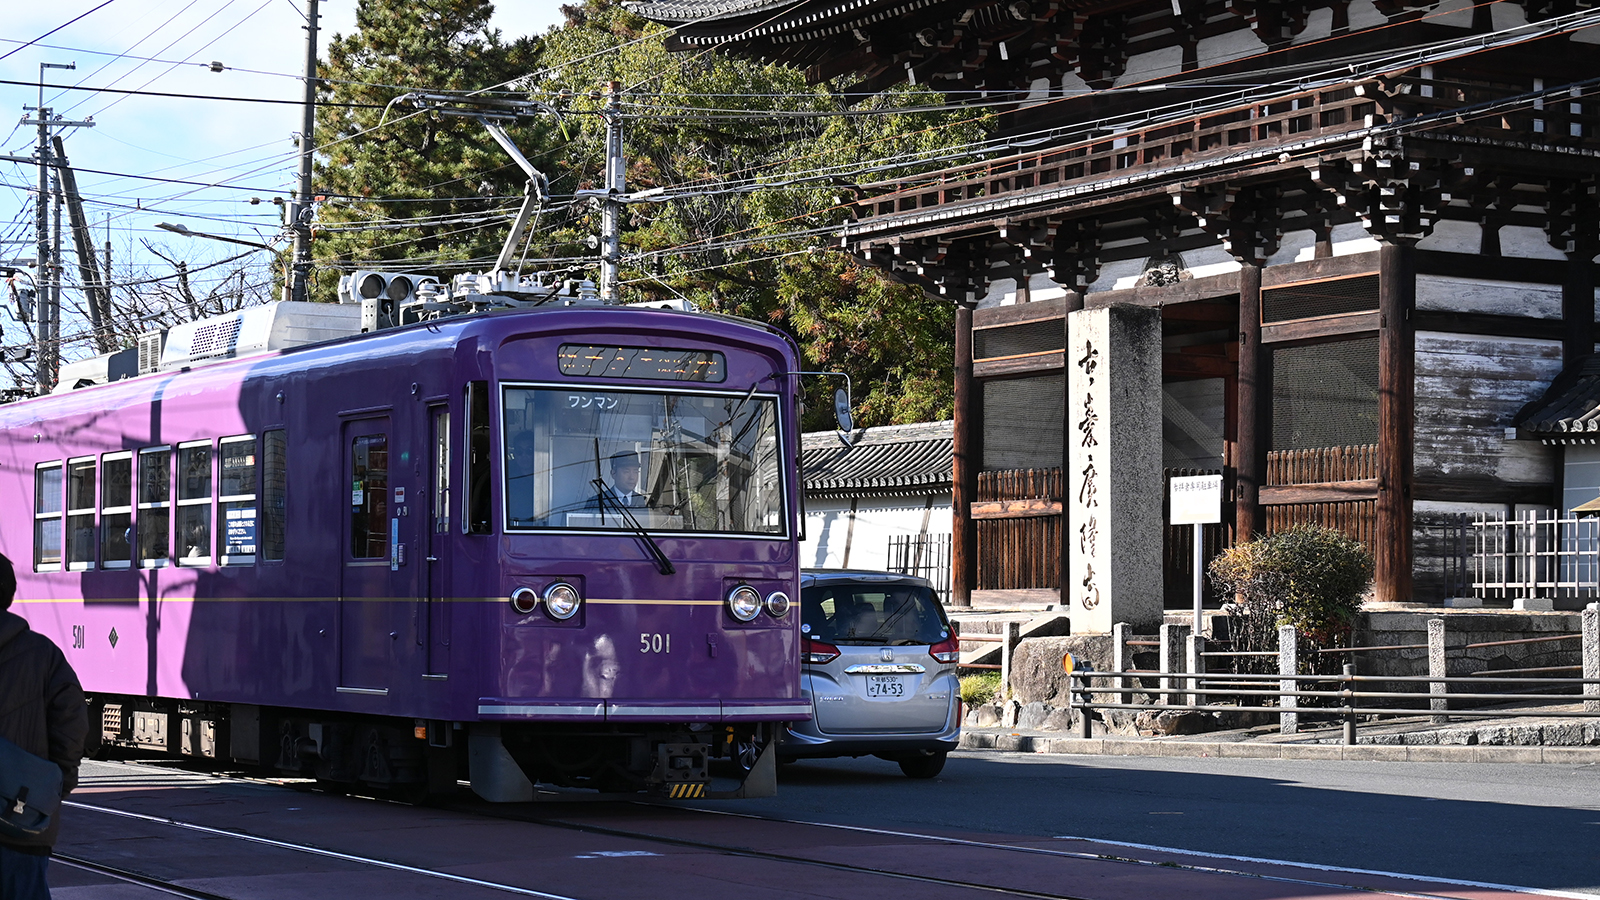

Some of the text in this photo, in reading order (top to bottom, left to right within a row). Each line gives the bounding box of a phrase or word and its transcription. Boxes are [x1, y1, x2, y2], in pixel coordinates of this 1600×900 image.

[569, 395, 618, 409] ワンマン
[73, 625, 84, 649] 501
[640, 633, 670, 653] 501
